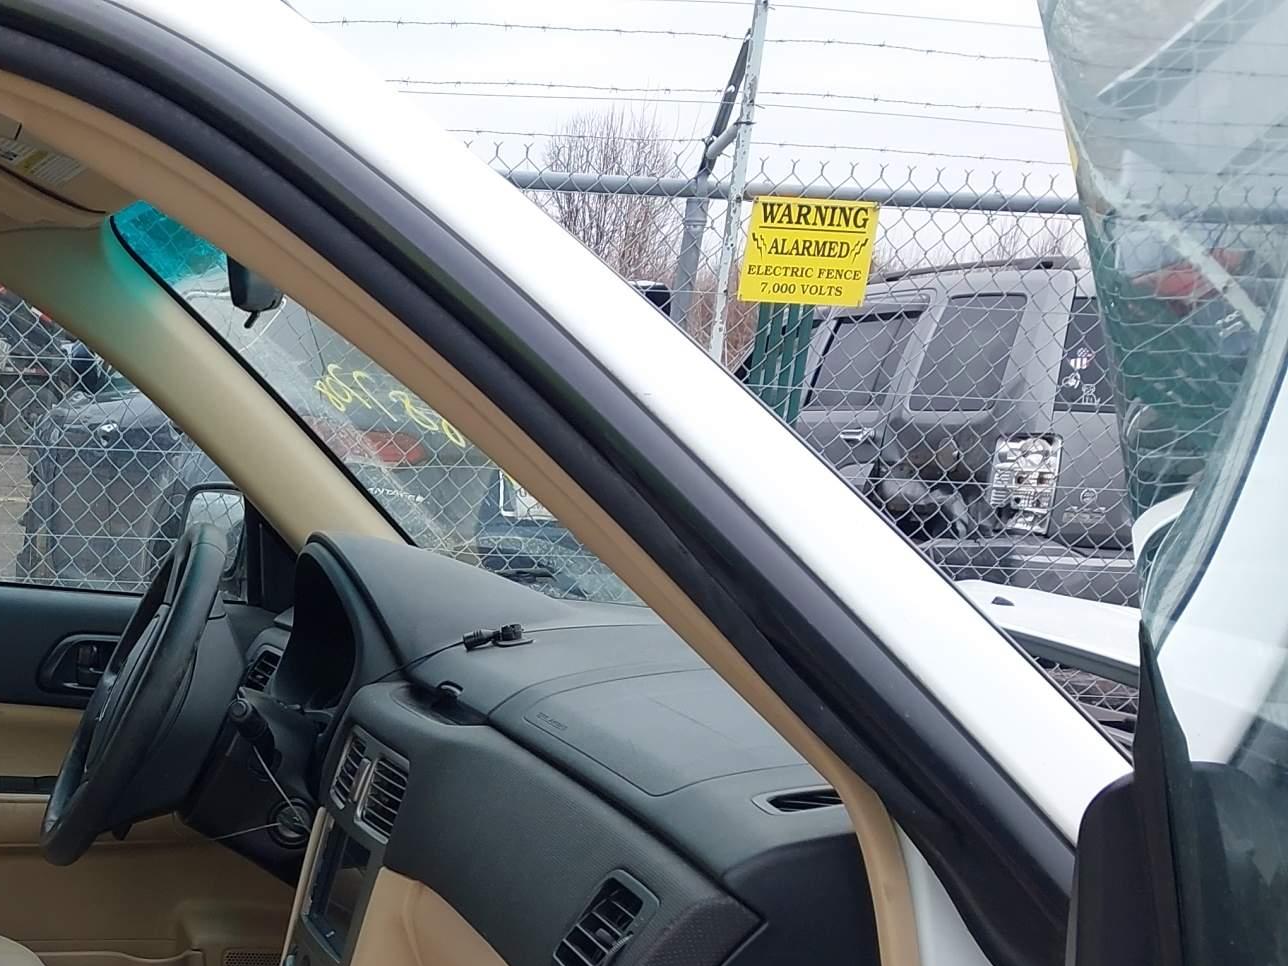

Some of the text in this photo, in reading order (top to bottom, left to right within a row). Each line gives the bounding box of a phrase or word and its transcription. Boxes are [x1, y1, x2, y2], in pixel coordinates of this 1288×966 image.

[762, 202, 869, 229] WARNING
[768, 238, 850, 258] ALARMED
[747, 264, 862, 281] ELECTRIC FENCE
[760, 282, 843, 297] 7,000 VOLTS
